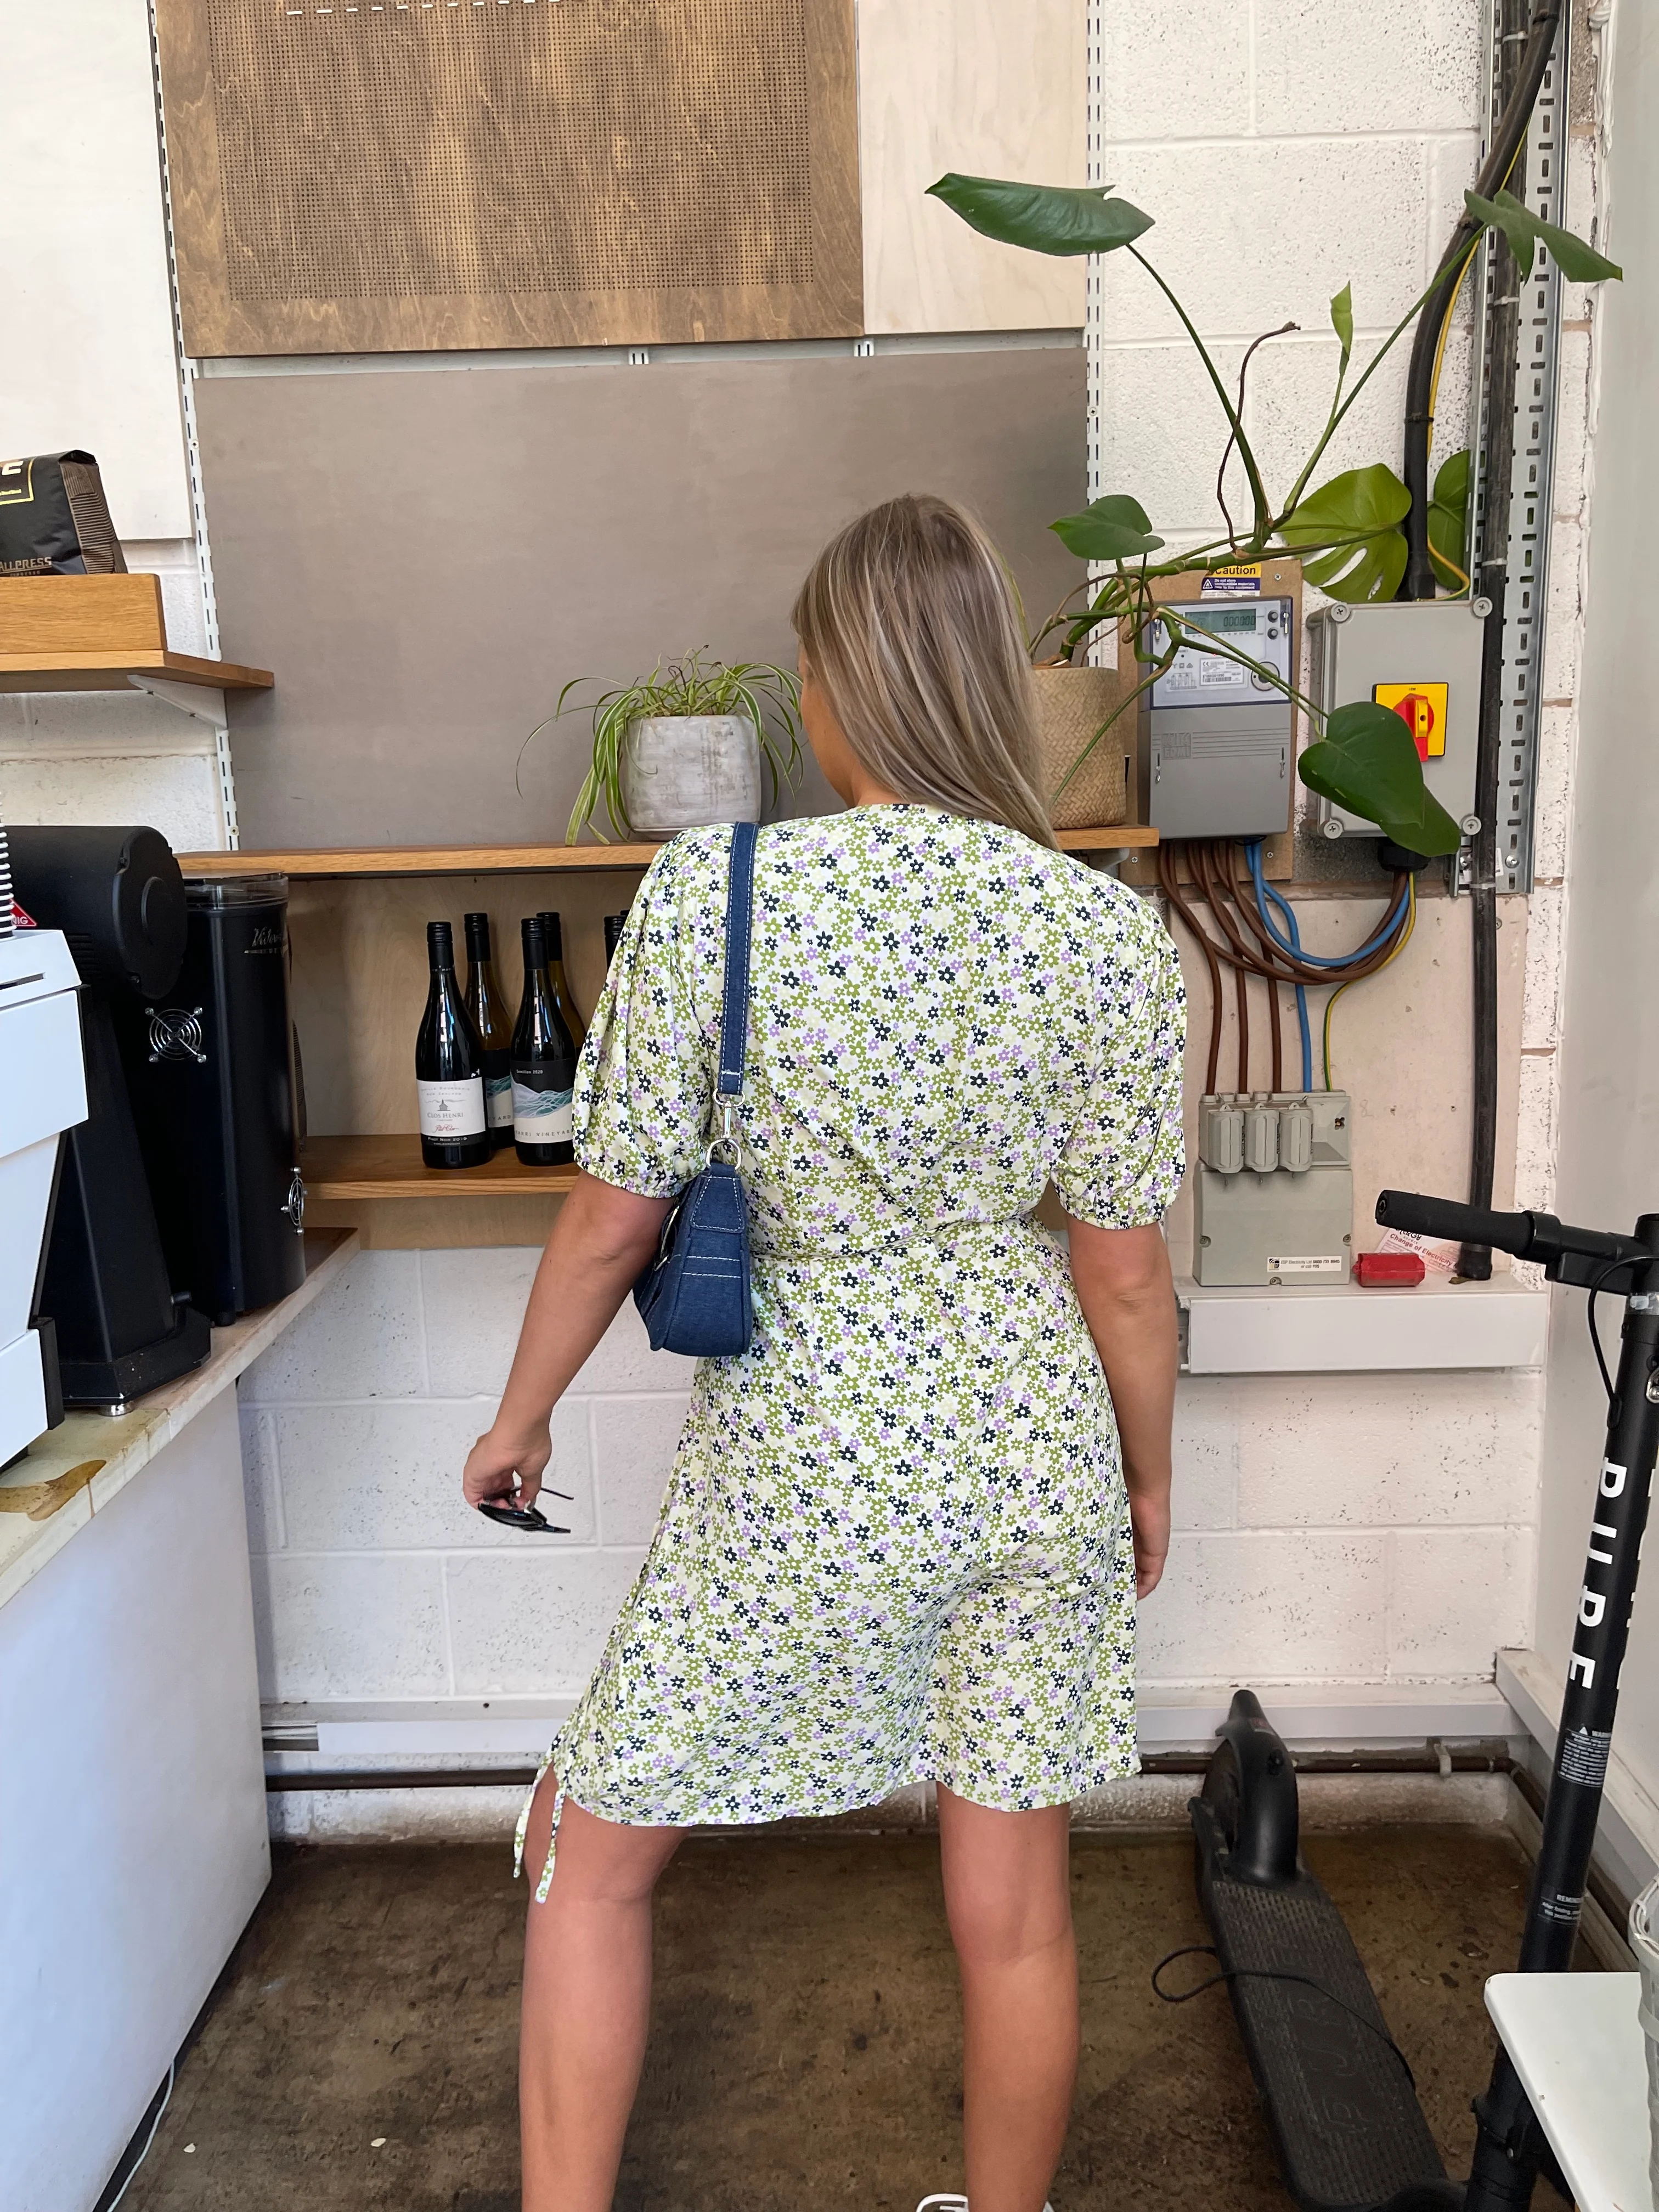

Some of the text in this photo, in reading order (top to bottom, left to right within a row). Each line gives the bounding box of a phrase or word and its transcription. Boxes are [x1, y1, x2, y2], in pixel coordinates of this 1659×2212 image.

[0, 557, 52, 572] ALLPRESS
[1390, 1233, 1413, 1248] Change
[1422, 1248, 1453, 1266] Electricity
[1570, 1457, 1627, 1689] PURE
